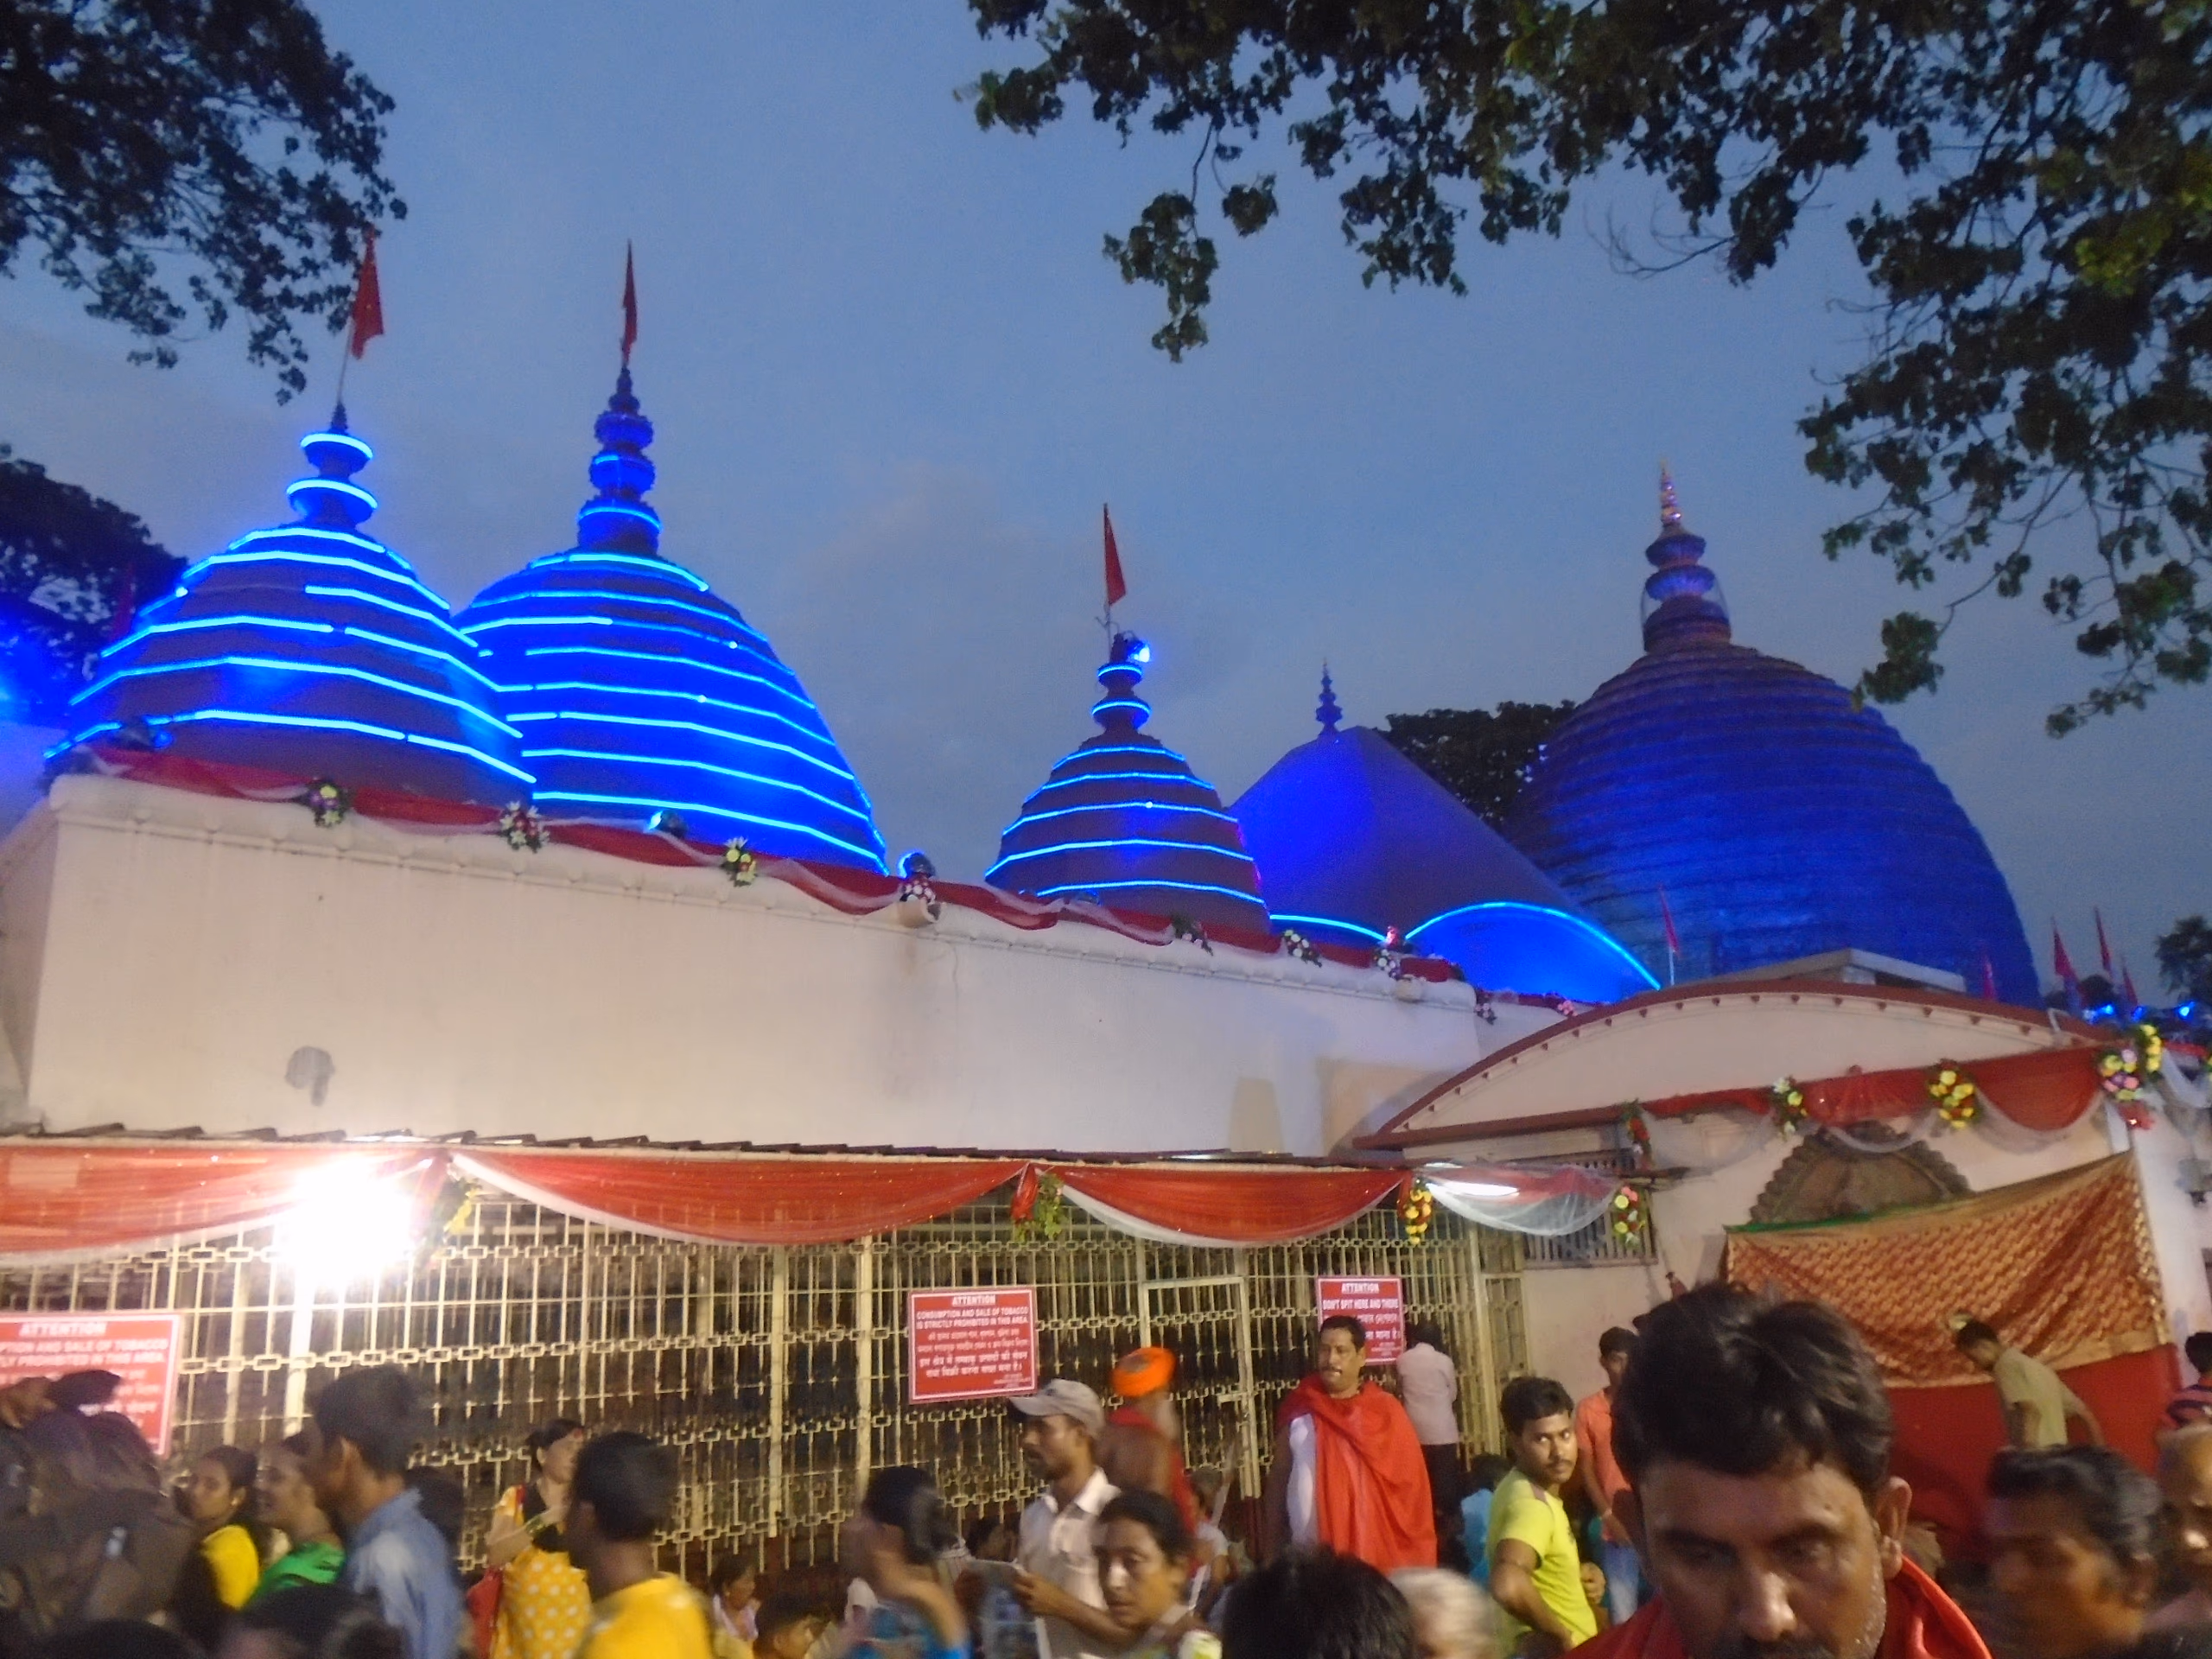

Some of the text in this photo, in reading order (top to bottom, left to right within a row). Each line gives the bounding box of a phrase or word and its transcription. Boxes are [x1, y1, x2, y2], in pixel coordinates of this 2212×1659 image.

[1341, 1283, 1380, 1294] ATTENTION
[951, 1294, 996, 1306] ATTENTION
[1340, 1299, 1353, 1309] SPIT
[1354, 1299, 1369, 1309] HERE
[1370, 1299, 1381, 1308] AND
[1382, 1299, 1399, 1308] THERE
[917, 1306, 1029, 1320] CONSUMPTION AND SALE OF TOBACCO
[18, 1322, 108, 1337] ATTENTION
[916, 1320, 924, 1330] IS
[925, 1319, 953, 1329] STRICTLY
[954, 1318, 990, 1327] PROHIBITED
[990, 1317, 997, 1325] IN
[997, 1317, 1011, 1325] THIS
[35, 1341, 62, 1353] AND
[63, 1340, 94, 1352] SALE
[95, 1340, 112, 1351] OF
[113, 1339, 169, 1351] TOBACCO
[17, 1354, 90, 1366] PROHIBITED
[90, 1354, 104, 1364] IN
[105, 1353, 131, 1363] THIS
